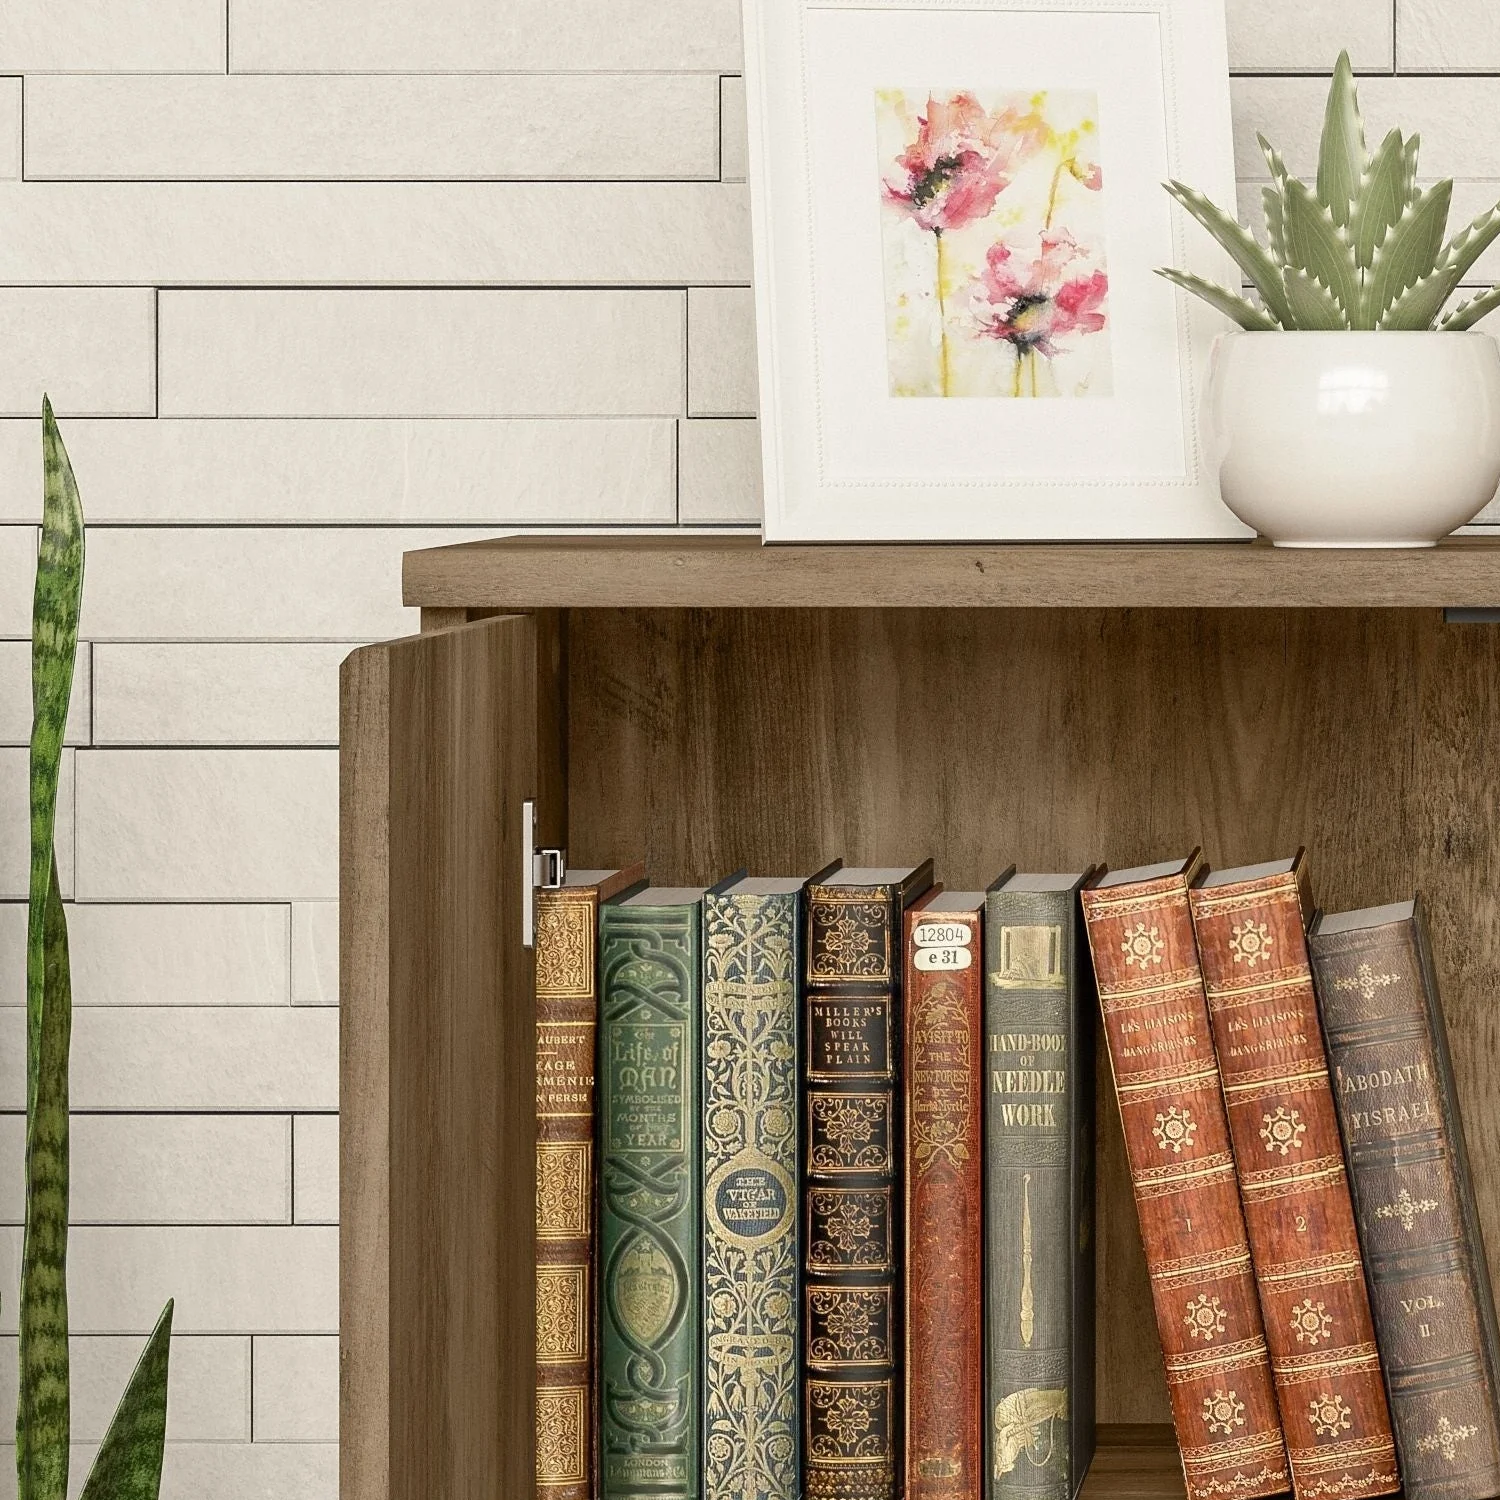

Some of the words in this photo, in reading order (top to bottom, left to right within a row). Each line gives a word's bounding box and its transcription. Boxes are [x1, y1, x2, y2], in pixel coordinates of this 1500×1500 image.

[920, 927, 964, 942] 12804
[928, 953, 938, 964] e
[941, 950, 960, 964] 31
[814, 1006, 882, 1017] MILLER'S
[825, 1017, 867, 1028] BOOKS
[830, 1030, 863, 1041] WILL
[824, 1041, 871, 1052] SPEAK
[826, 1054, 872, 1065] PLAIN
[929, 1051, 951, 1062] THE
[1019, 1055, 1036, 1067] OF
[934, 1070, 970, 1083] FOREST
[991, 1070, 1066, 1094] NEEDLE
[1344, 1063, 1429, 1093] ABODATH
[1001, 1103, 1057, 1127] WORK
[1352, 1101, 1436, 1129] YISRAEL
[625, 1133, 667, 1146] YEAR
[736, 1176, 766, 1187] THE
[726, 1187, 778, 1201] VICAR
[722, 1207, 780, 1221] WAKEFIELD
[1295, 1215, 1307, 1232] 2
[1400, 1295, 1445, 1313] VOL.
